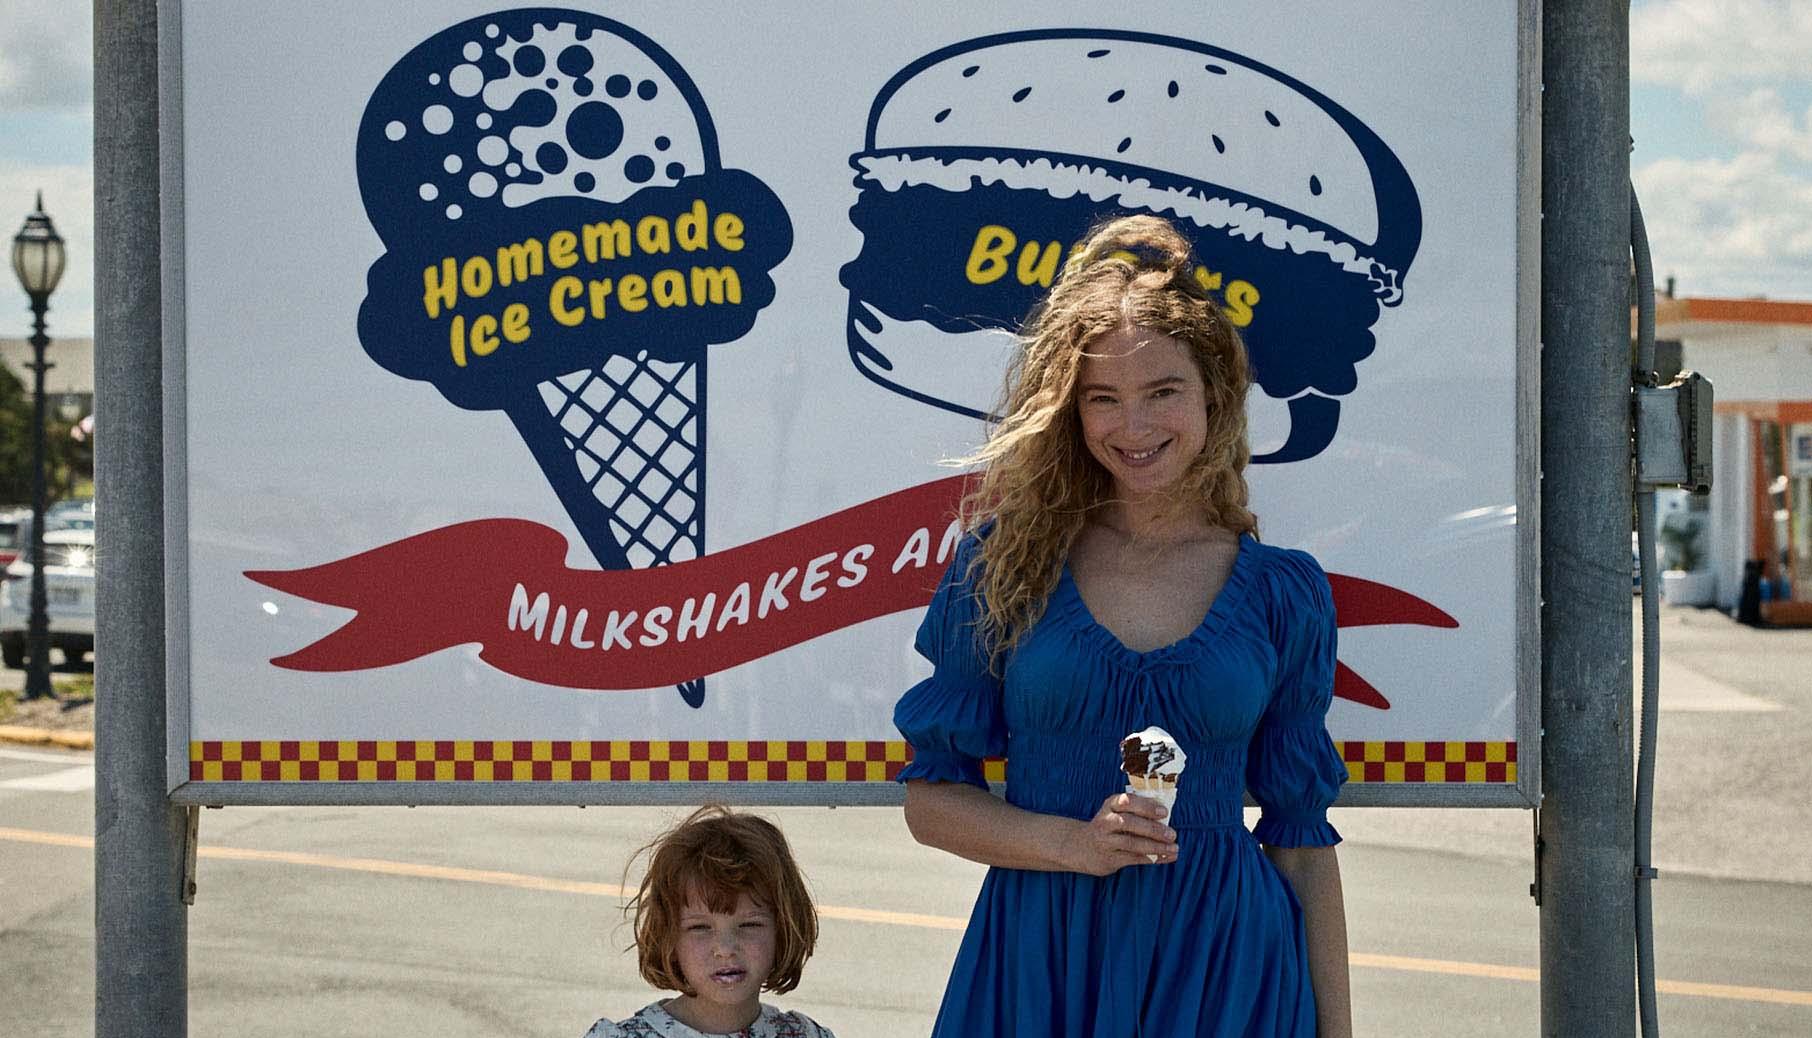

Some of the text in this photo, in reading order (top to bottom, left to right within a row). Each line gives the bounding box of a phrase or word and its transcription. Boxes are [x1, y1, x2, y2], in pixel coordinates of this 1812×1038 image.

[423, 199, 745, 319] Homemade
[450, 265, 743, 366] Ice Cream
[507, 543, 875, 651] MILKSHAKES
